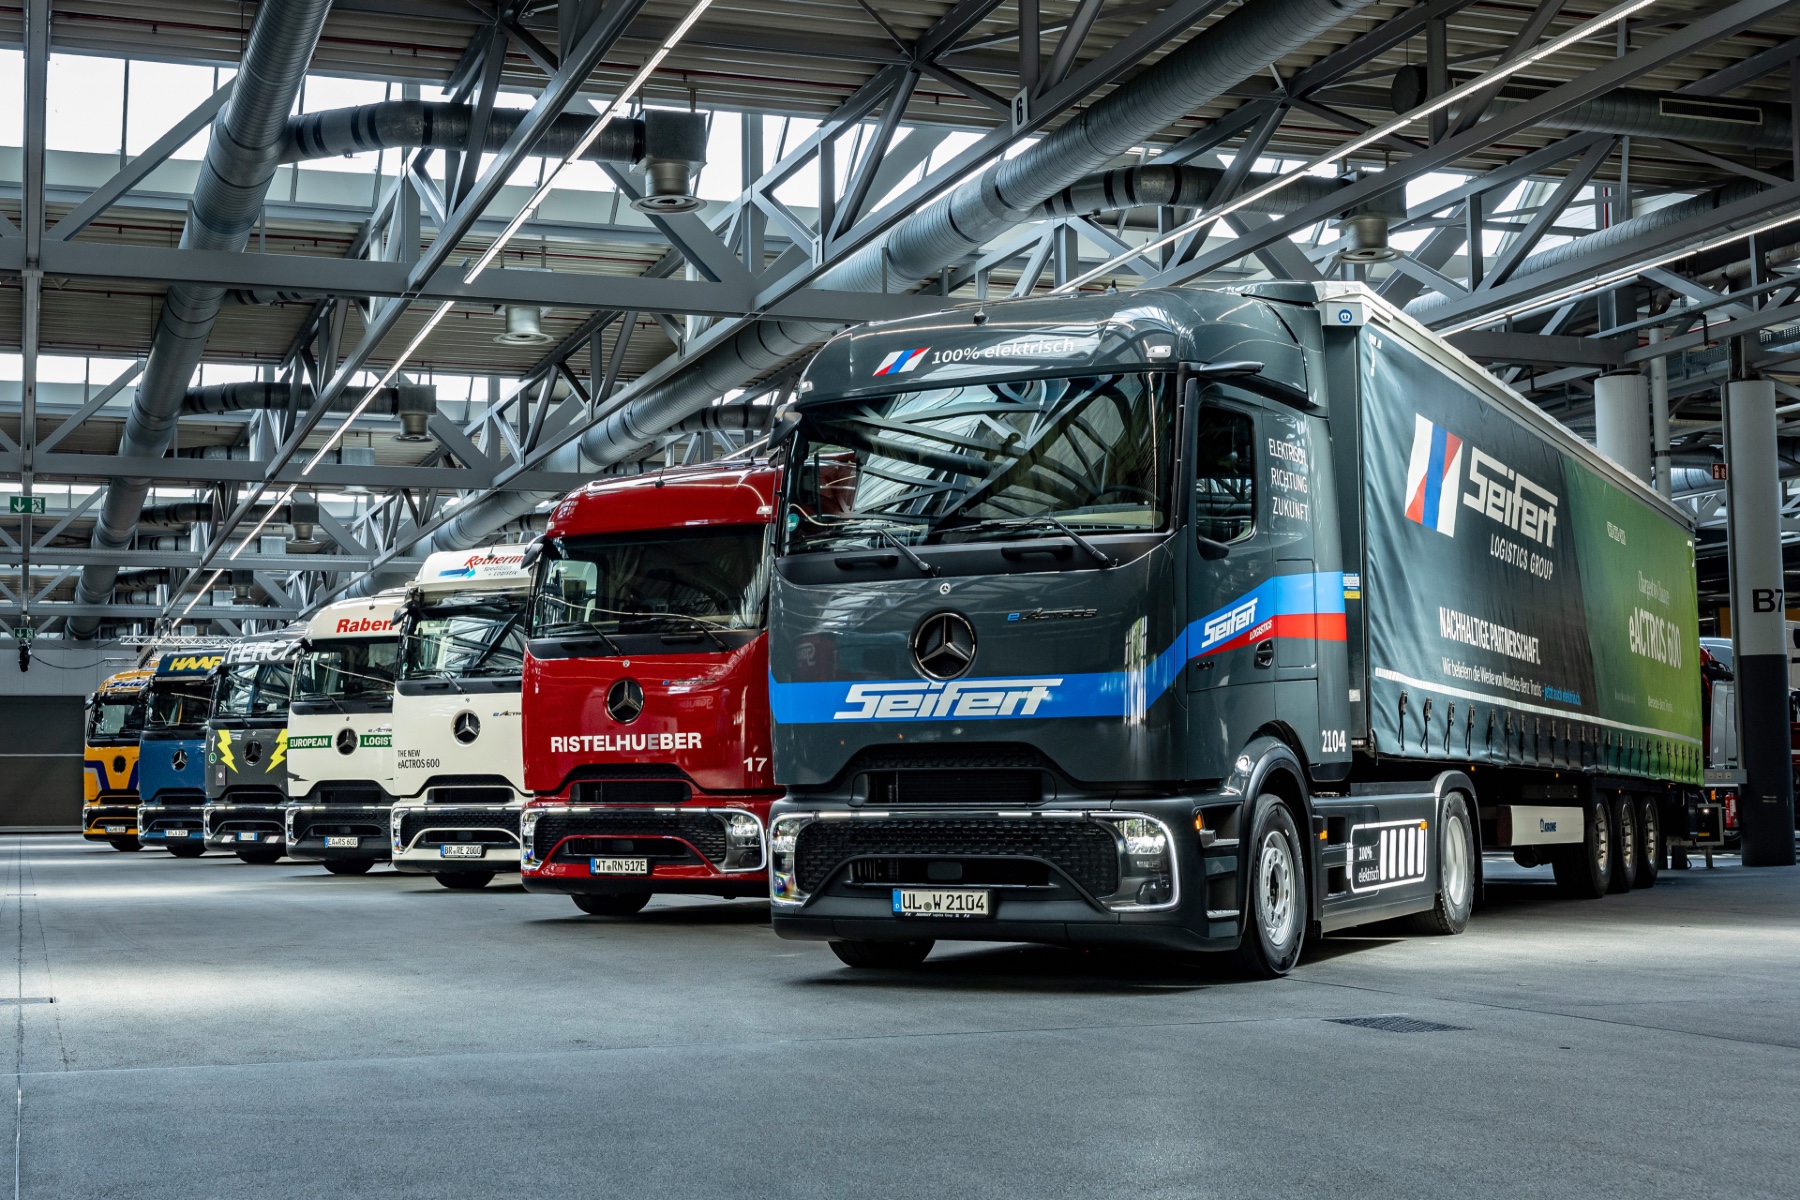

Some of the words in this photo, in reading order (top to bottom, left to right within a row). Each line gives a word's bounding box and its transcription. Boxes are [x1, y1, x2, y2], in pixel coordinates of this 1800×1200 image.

[1016, 96, 1023, 126] 6
[931, 348, 980, 364] 100%
[984, 338, 1074, 358] elektrisch
[1270, 467, 1308, 494] RICHTUNG
[1463, 446, 1558, 549] Seifert
[1490, 533, 1528, 571] LOGISTICS
[1530, 552, 1553, 581] GROUP
[1752, 588, 1784, 613] B7
[1201, 597, 1258, 649] Seifert
[1249, 619, 1273, 641] LOGISTICS
[1439, 606, 1490, 651] NACHHALTIGE
[1629, 606, 1667, 665] eACTROS
[1667, 621, 1682, 671] 600
[833, 678, 1063, 720] Seifert
[289, 737, 329, 748] EUROPEAN
[550, 732, 702, 753] RISTELHUEBER
[1322, 729, 1347, 753] 2104
[397, 759, 425, 768] eACTROS
[426, 758, 440, 768] 600
[407, 749, 421, 757] NEW
[742, 756, 768, 772] 17
[346, 837, 357, 846] 600
[444, 847, 453, 855] BR
[456, 847, 465, 855] RE
[466, 847, 481, 855] 2000
[1359, 846, 1373, 860] 100%
[612, 860, 623, 872] RN
[624, 860, 646, 872] 517E
[1358, 866, 1380, 883] elektrisch
[902, 893, 922, 909] UL
[932, 894, 942, 910] W
[945, 894, 985, 911] 2104
